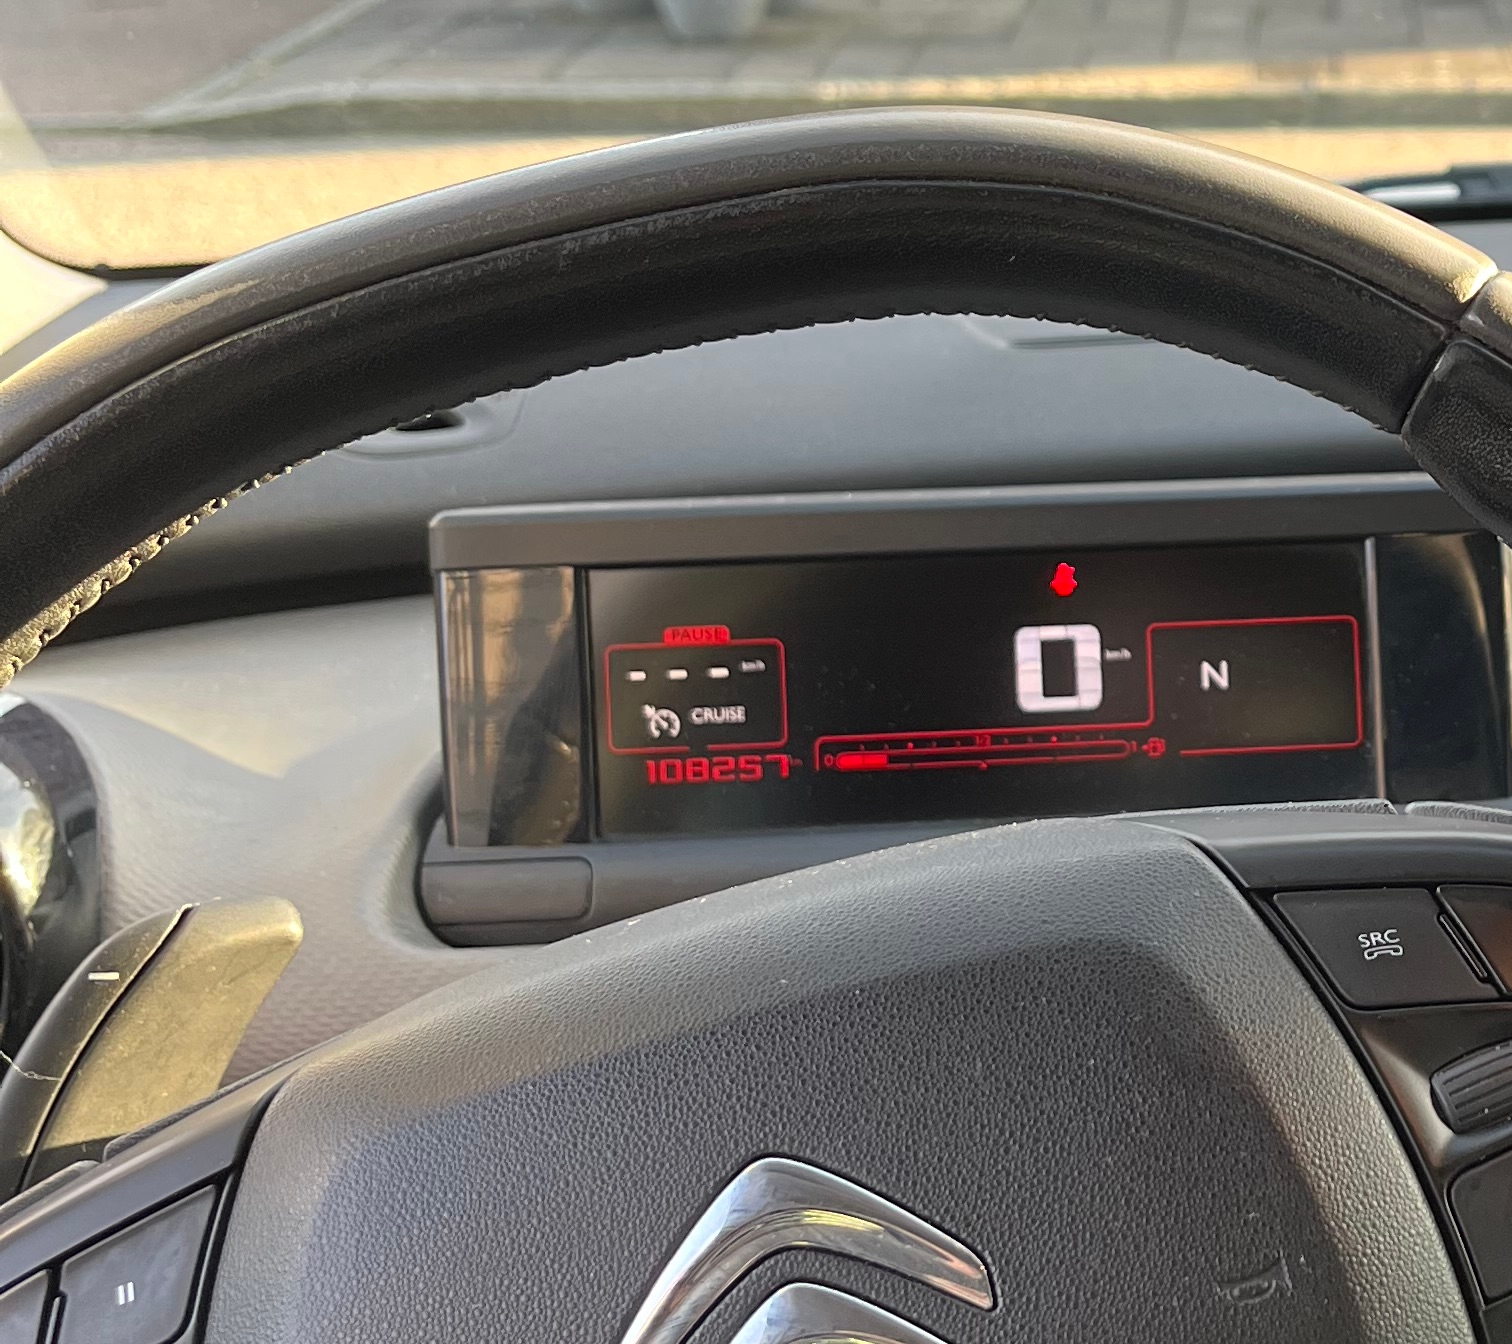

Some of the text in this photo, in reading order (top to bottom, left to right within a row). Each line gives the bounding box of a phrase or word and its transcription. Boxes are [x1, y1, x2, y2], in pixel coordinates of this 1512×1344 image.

[670, 626, 722, 641] PAUSE
[1013, 623, 1103, 713] 0
[1200, 659, 1230, 691] N
[690, 705, 747, 725] CRUISE
[645, 753, 790, 785] 108257
[1357, 928, 1401, 948] SRC
